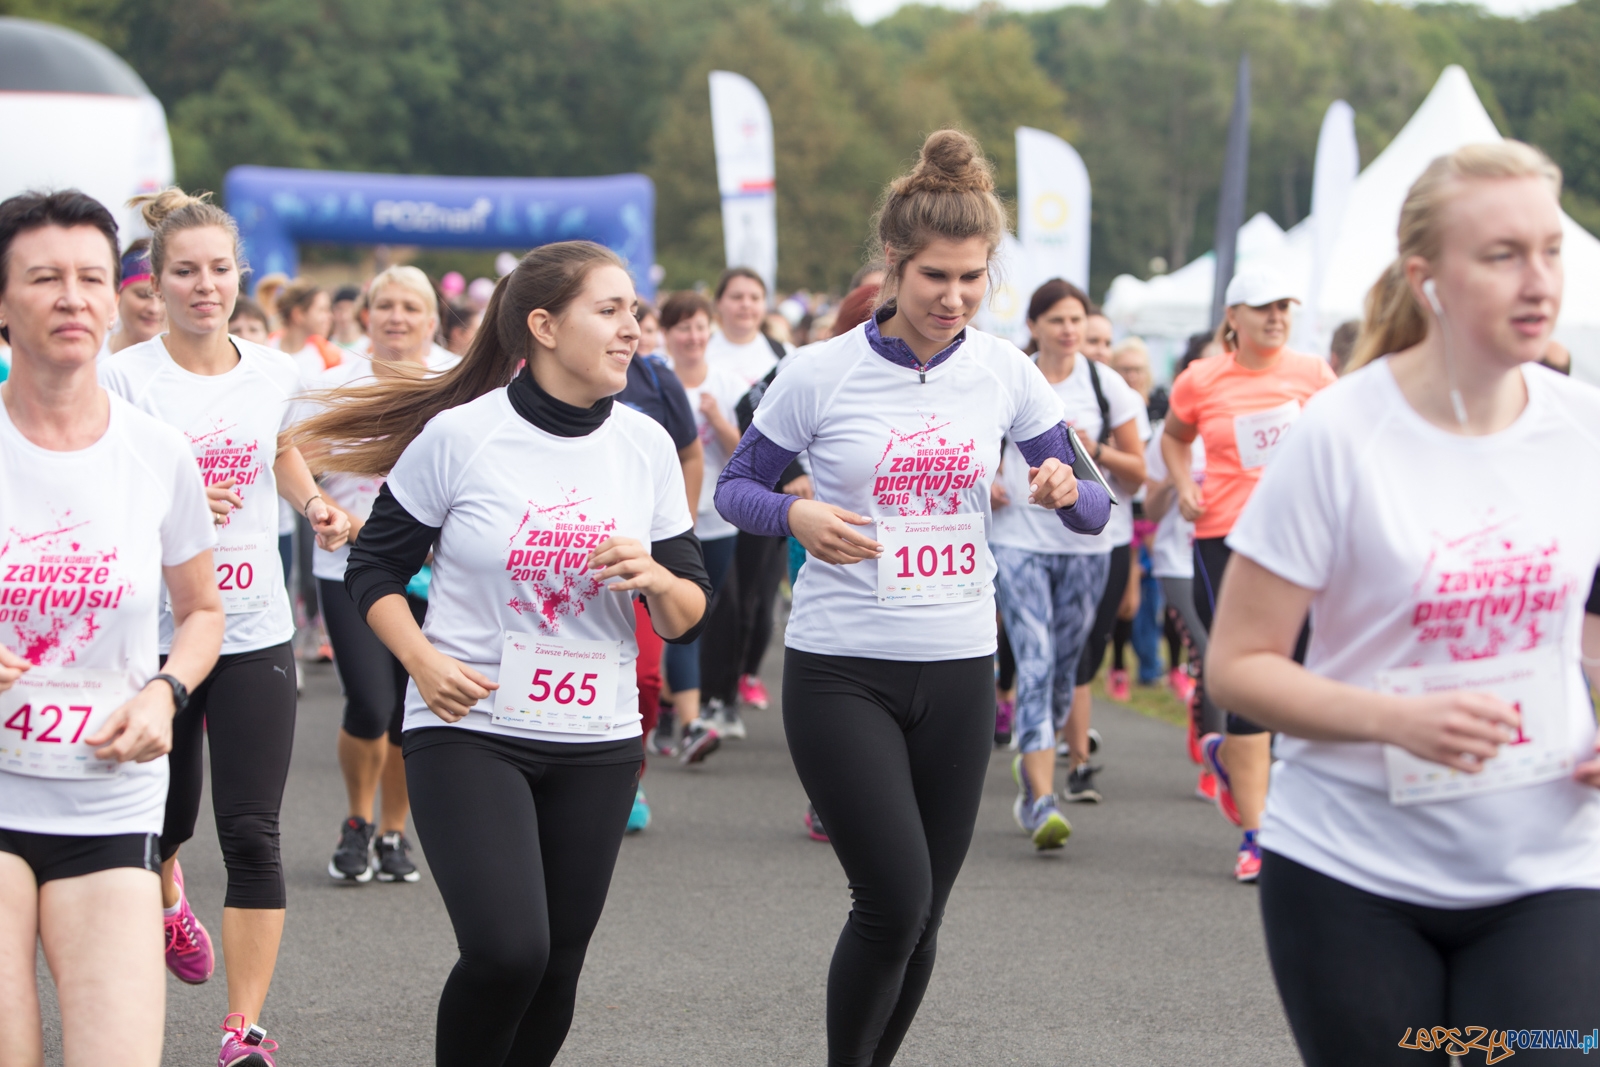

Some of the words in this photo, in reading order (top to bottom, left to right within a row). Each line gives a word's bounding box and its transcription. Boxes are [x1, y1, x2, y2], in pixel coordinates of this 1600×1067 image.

[1253, 422, 1291, 450] 32
[205, 448, 220, 456] BIEG
[221, 447, 244, 455] KOBIET
[935, 448, 961, 456] KOBIET
[889, 455, 970, 472] zawsze
[872, 469, 979, 496] pier(w)si!
[877, 492, 910, 505] 2016
[555, 523, 573, 531] BIEG
[574, 524, 601, 532] KOBIET
[904, 525, 930, 533] Zawsze
[931, 524, 957, 532] Pier(w)si
[957, 523, 972, 531] 2016
[895, 543, 976, 578] 1013
[4, 565, 109, 584] zawsze
[511, 569, 547, 581] 2016
[1437, 564, 1552, 594] zawsze
[0, 586, 123, 615] ier(w)si!
[535, 647, 561, 656] Zawsze
[563, 650, 590, 659] Pier(w)si
[528, 668, 598, 706] 565
[4, 703, 92, 744] 427
